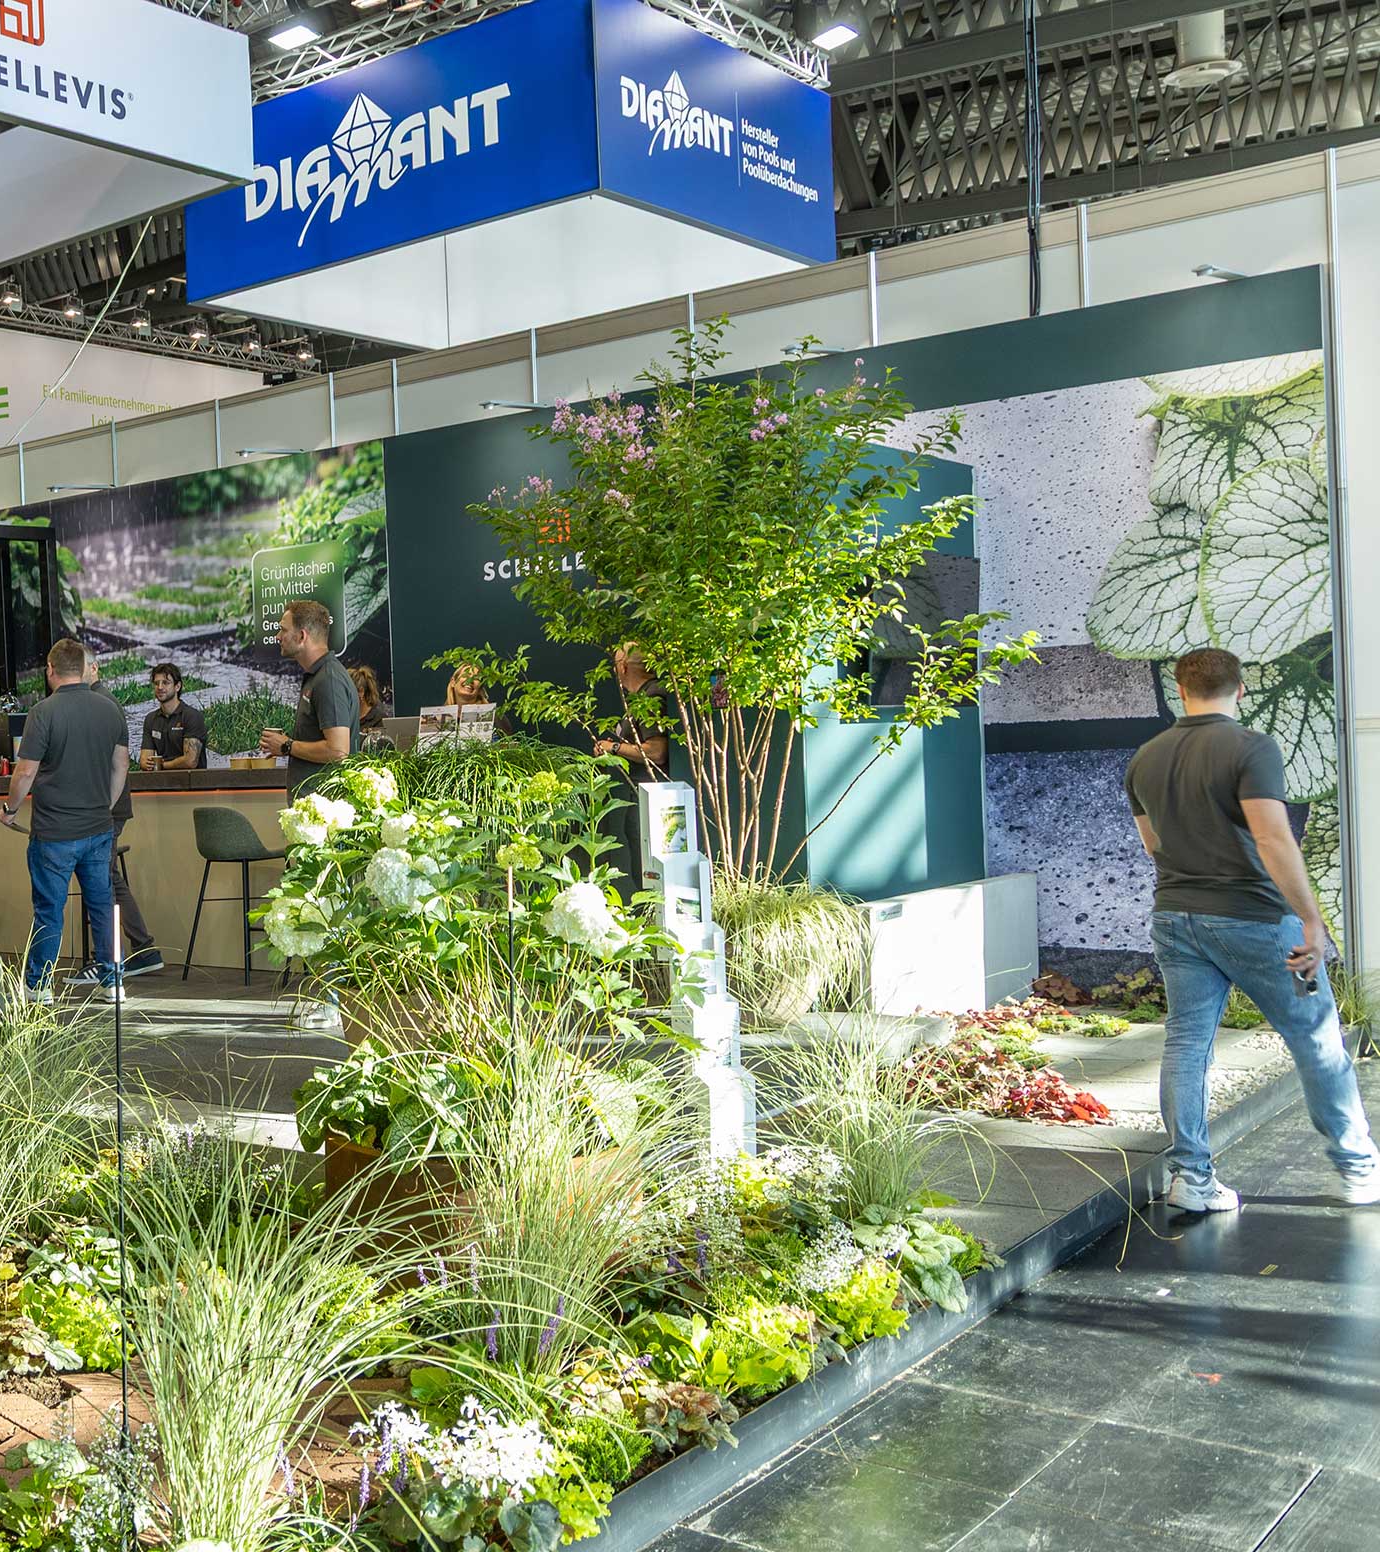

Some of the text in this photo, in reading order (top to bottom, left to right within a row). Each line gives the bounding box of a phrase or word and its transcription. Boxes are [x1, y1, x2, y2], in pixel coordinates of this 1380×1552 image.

[741, 118, 780, 148] Hersteller
[742, 141, 796, 175] von Pools und
[743, 158, 819, 202] Poolüberdachungen
[60, 387, 155, 413] Familienunternehmen
[261, 560, 335, 581] Grünflächen
[261, 579, 319, 598] im Mittel-
[262, 599, 288, 618] pun
